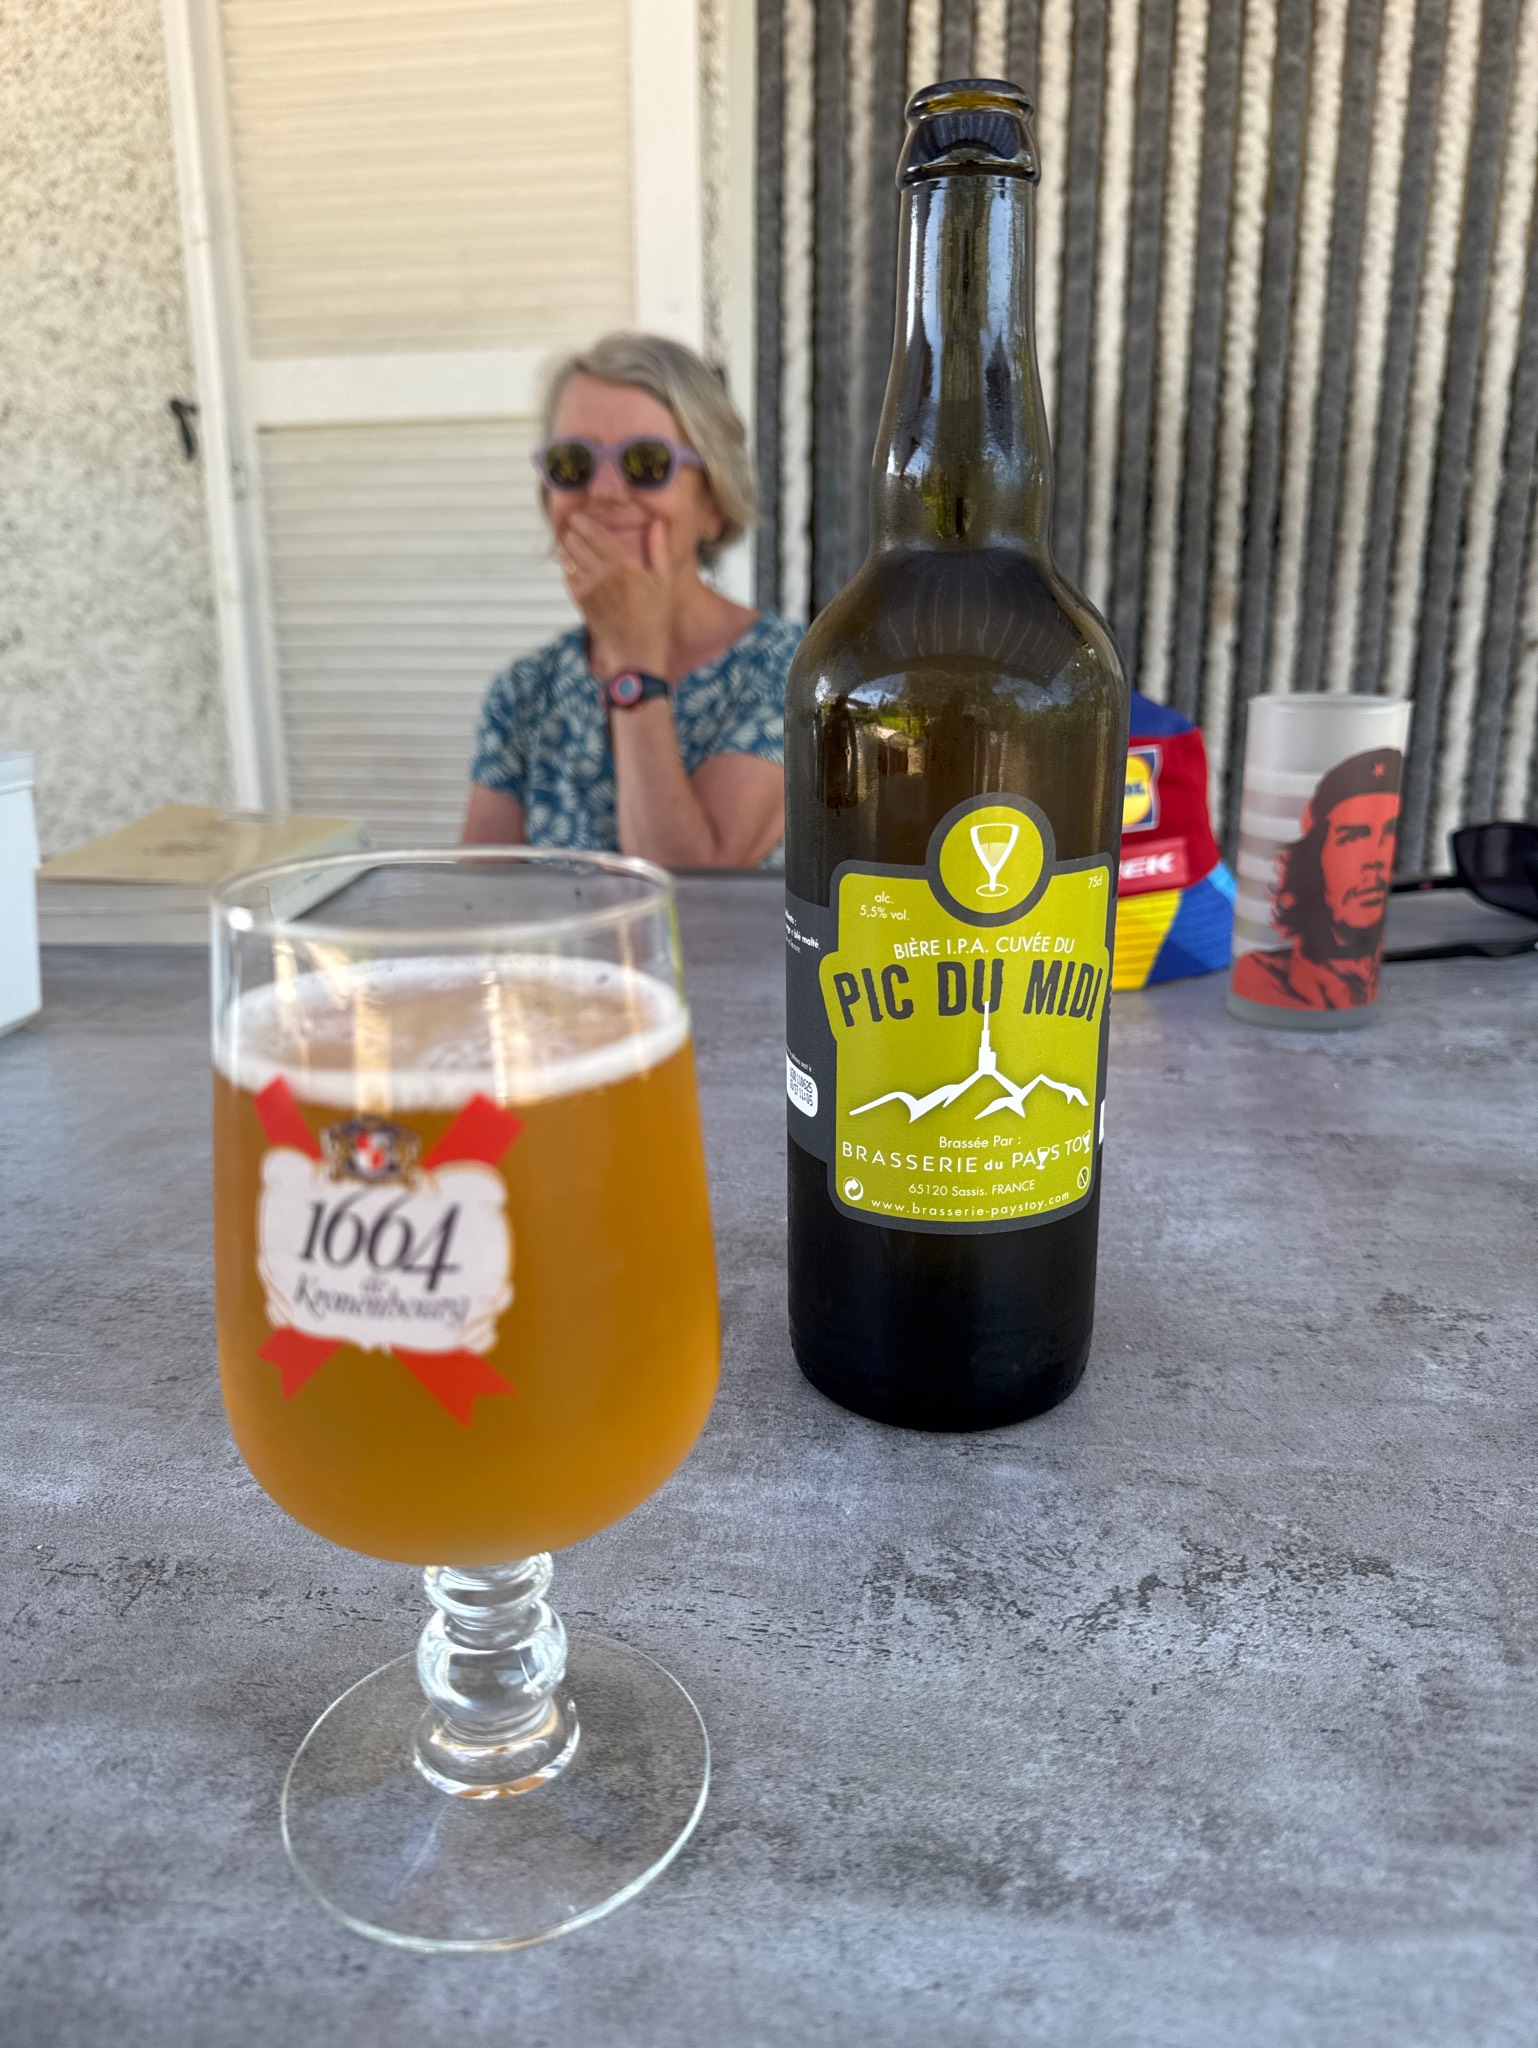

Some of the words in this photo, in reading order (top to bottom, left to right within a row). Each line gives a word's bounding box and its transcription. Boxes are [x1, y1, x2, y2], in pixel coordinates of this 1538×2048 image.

[1119, 850, 1176, 880] EK
[1087, 873, 1103, 889] 75cl
[874, 890, 894, 904] alc.
[858, 905, 888, 919] 5,5%
[890, 908, 910, 921] vol.
[893, 936, 941, 960] BIÈRE
[946, 938, 989, 955] I.P.A.
[995, 931, 1051, 953] CUVÉE
[1053, 936, 1076, 954] DU
[832, 963, 915, 1029] PIC
[935, 957, 1005, 1017] DU
[1022, 958, 1104, 1023] MIDI
[938, 1135, 989, 1149] Brassée
[993, 1135, 1014, 1148] Par
[841, 1140, 978, 1173] BRASSERIE
[983, 1158, 1004, 1172] du
[908, 1183, 948, 1197] 65120
[951, 1185, 988, 1197] Sassis.
[991, 1179, 1036, 1195] FRANCE
[870, 1191, 1070, 1218] www.brasserie-paystoy.com
[296, 1186, 464, 1293] 1664
